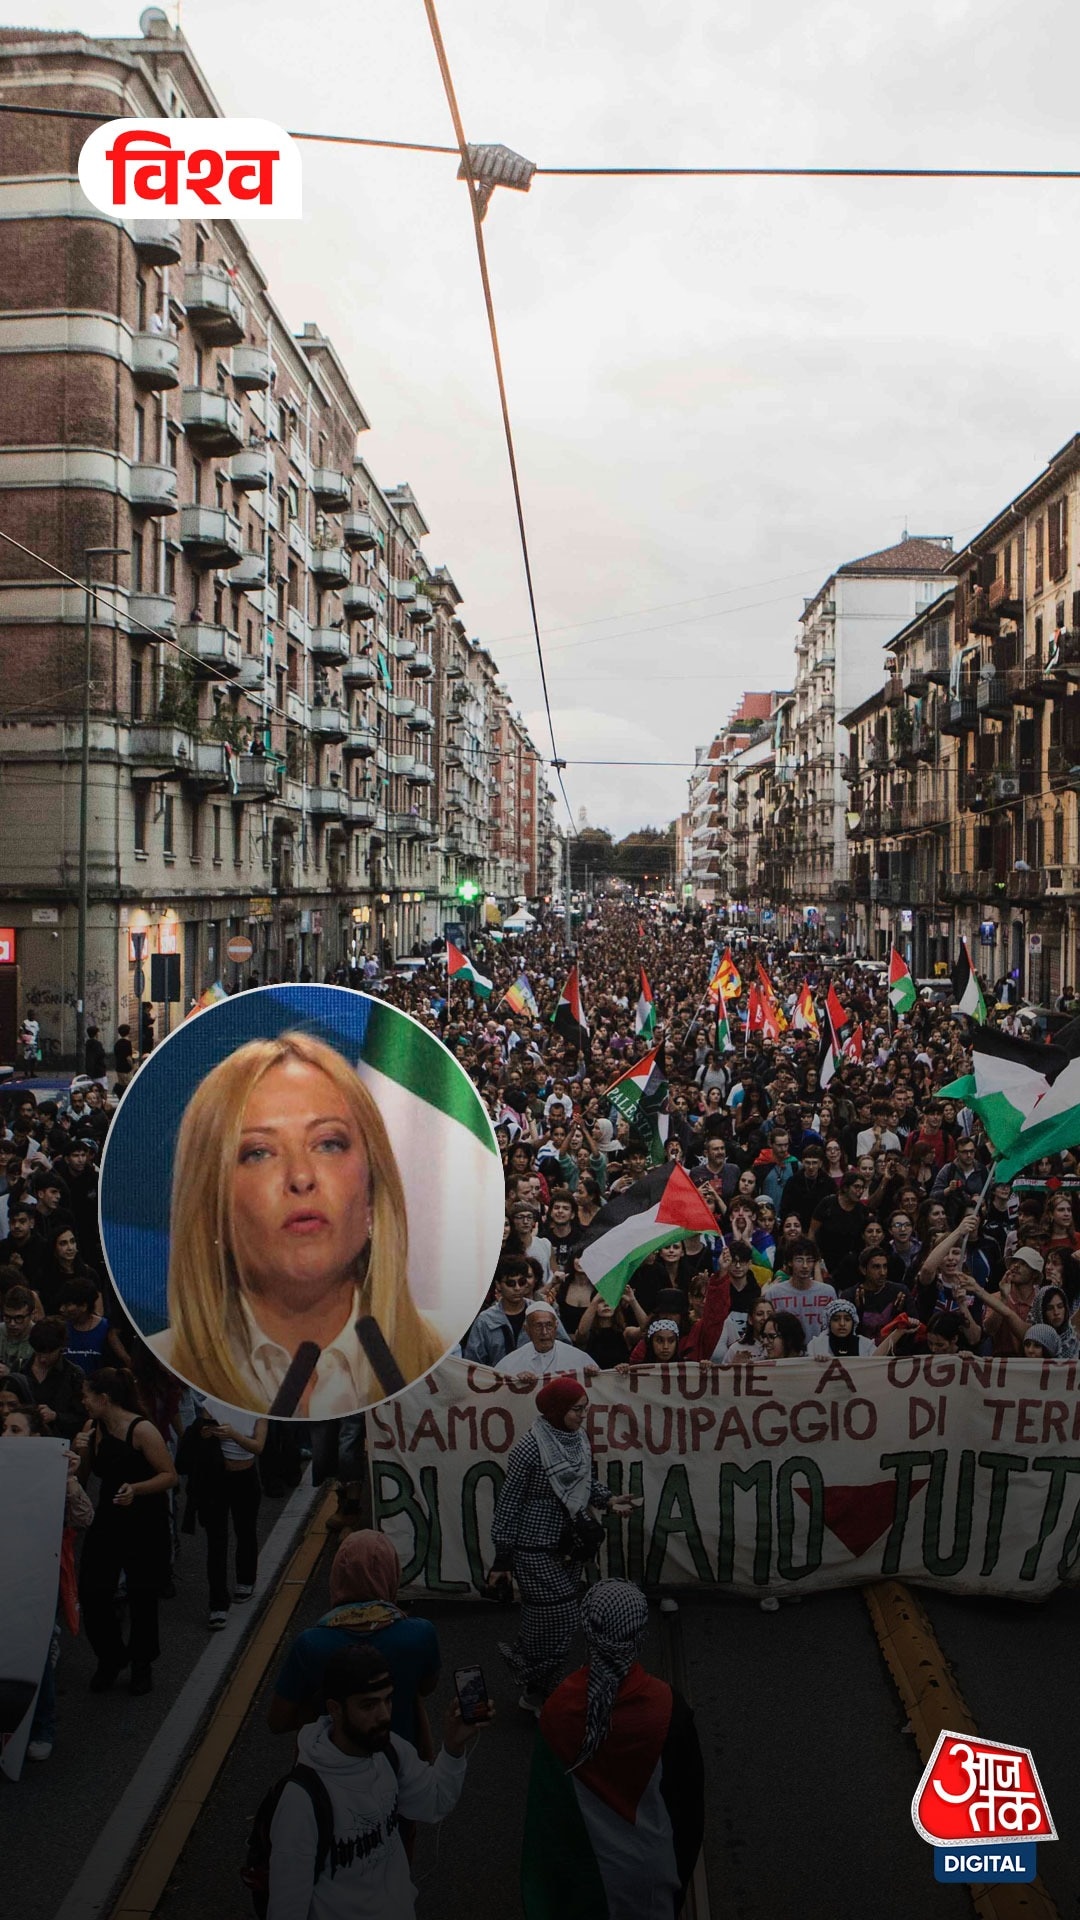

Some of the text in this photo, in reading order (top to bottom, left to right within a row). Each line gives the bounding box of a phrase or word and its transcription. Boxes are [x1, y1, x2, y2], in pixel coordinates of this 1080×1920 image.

[629, 1361, 774, 1401] FIUME
[815, 1358, 857, 1394] A
[887, 1356, 1008, 1389] OGNI
[371, 1400, 515, 1453] SIAMO
[908, 1396, 947, 1440] DI
